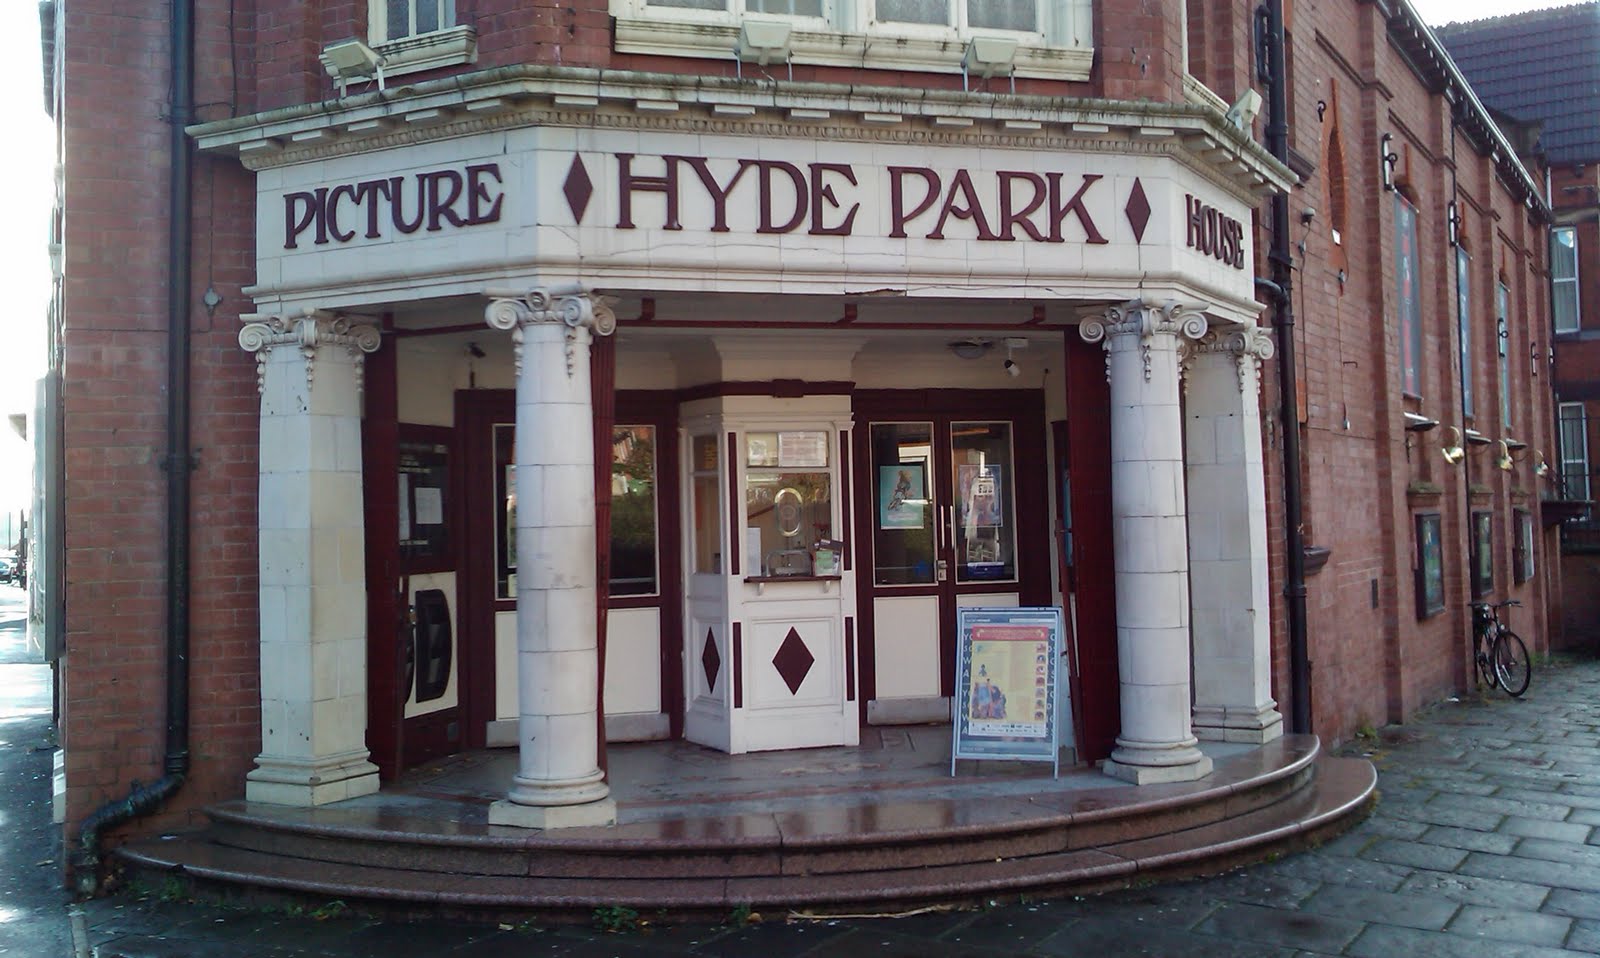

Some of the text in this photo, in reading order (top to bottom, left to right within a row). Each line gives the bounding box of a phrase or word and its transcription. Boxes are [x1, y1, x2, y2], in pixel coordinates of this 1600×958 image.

[283, 163, 504, 249] PICTURE
[615, 153, 1109, 244] HYDE PARK
[1185, 194, 1244, 270] HOUSE
